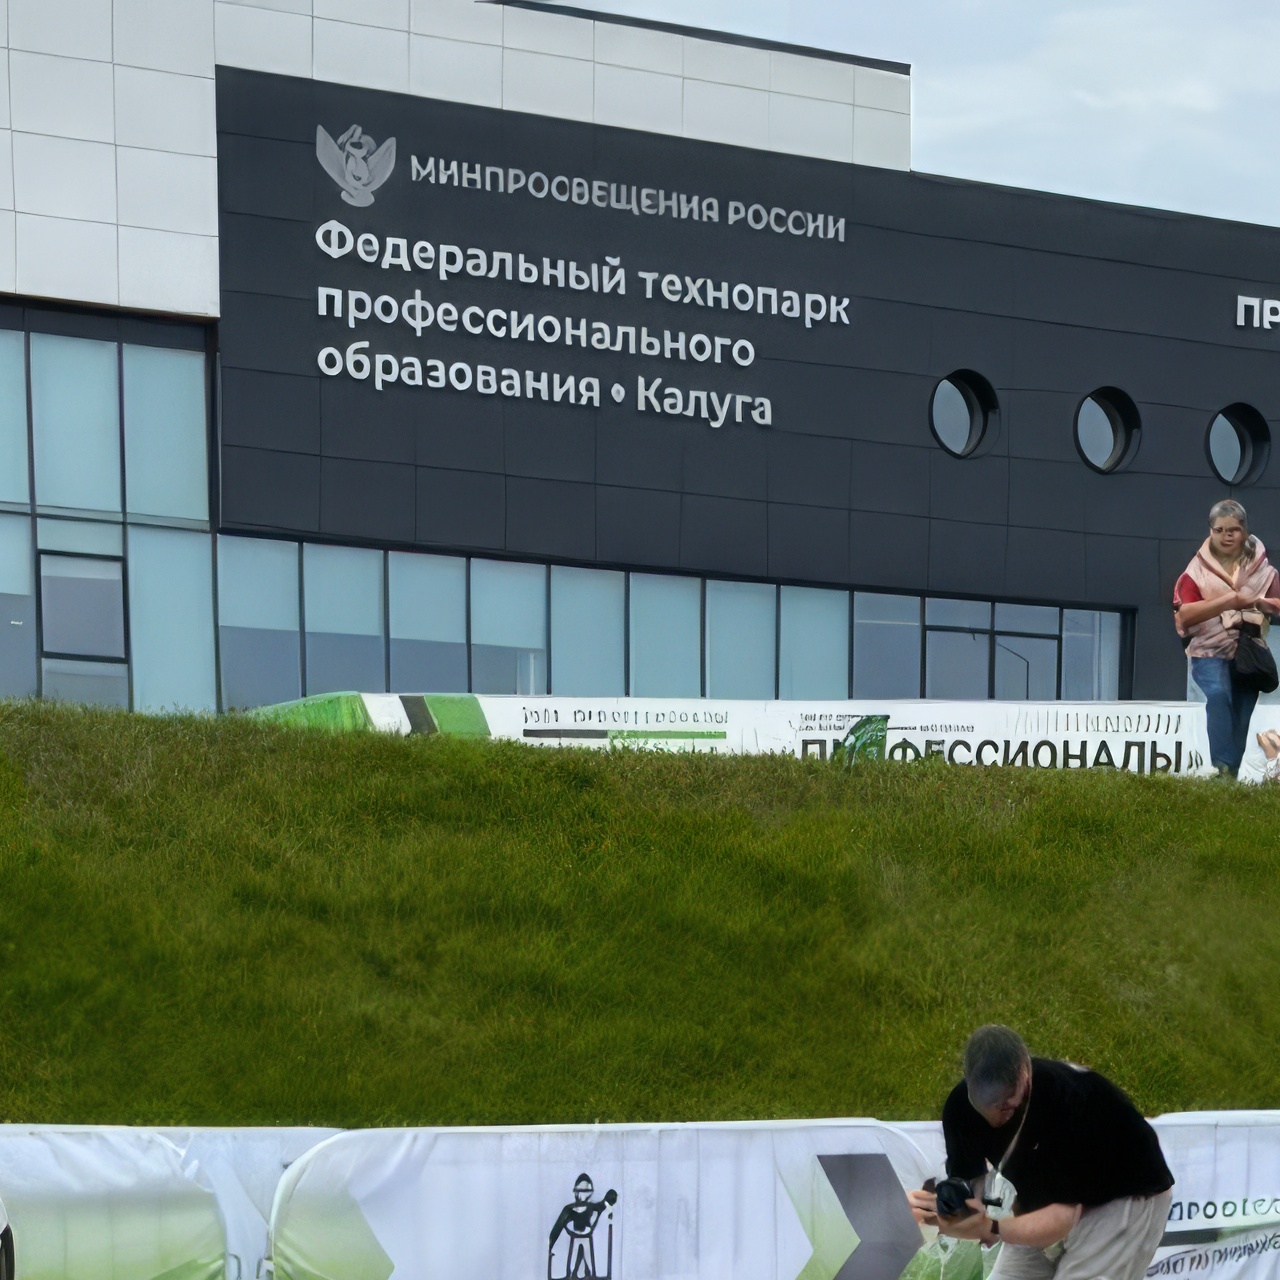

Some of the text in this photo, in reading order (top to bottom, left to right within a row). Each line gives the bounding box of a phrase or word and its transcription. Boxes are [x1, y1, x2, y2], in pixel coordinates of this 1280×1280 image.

[411, 155, 846, 241] МИНПРОСВЕЩЕНИЯ РОССИИ
[315, 220, 851, 328] Федеральный технопарк
[317, 286, 755, 367] профессионального
[317, 342, 772, 428] образования Калуга
